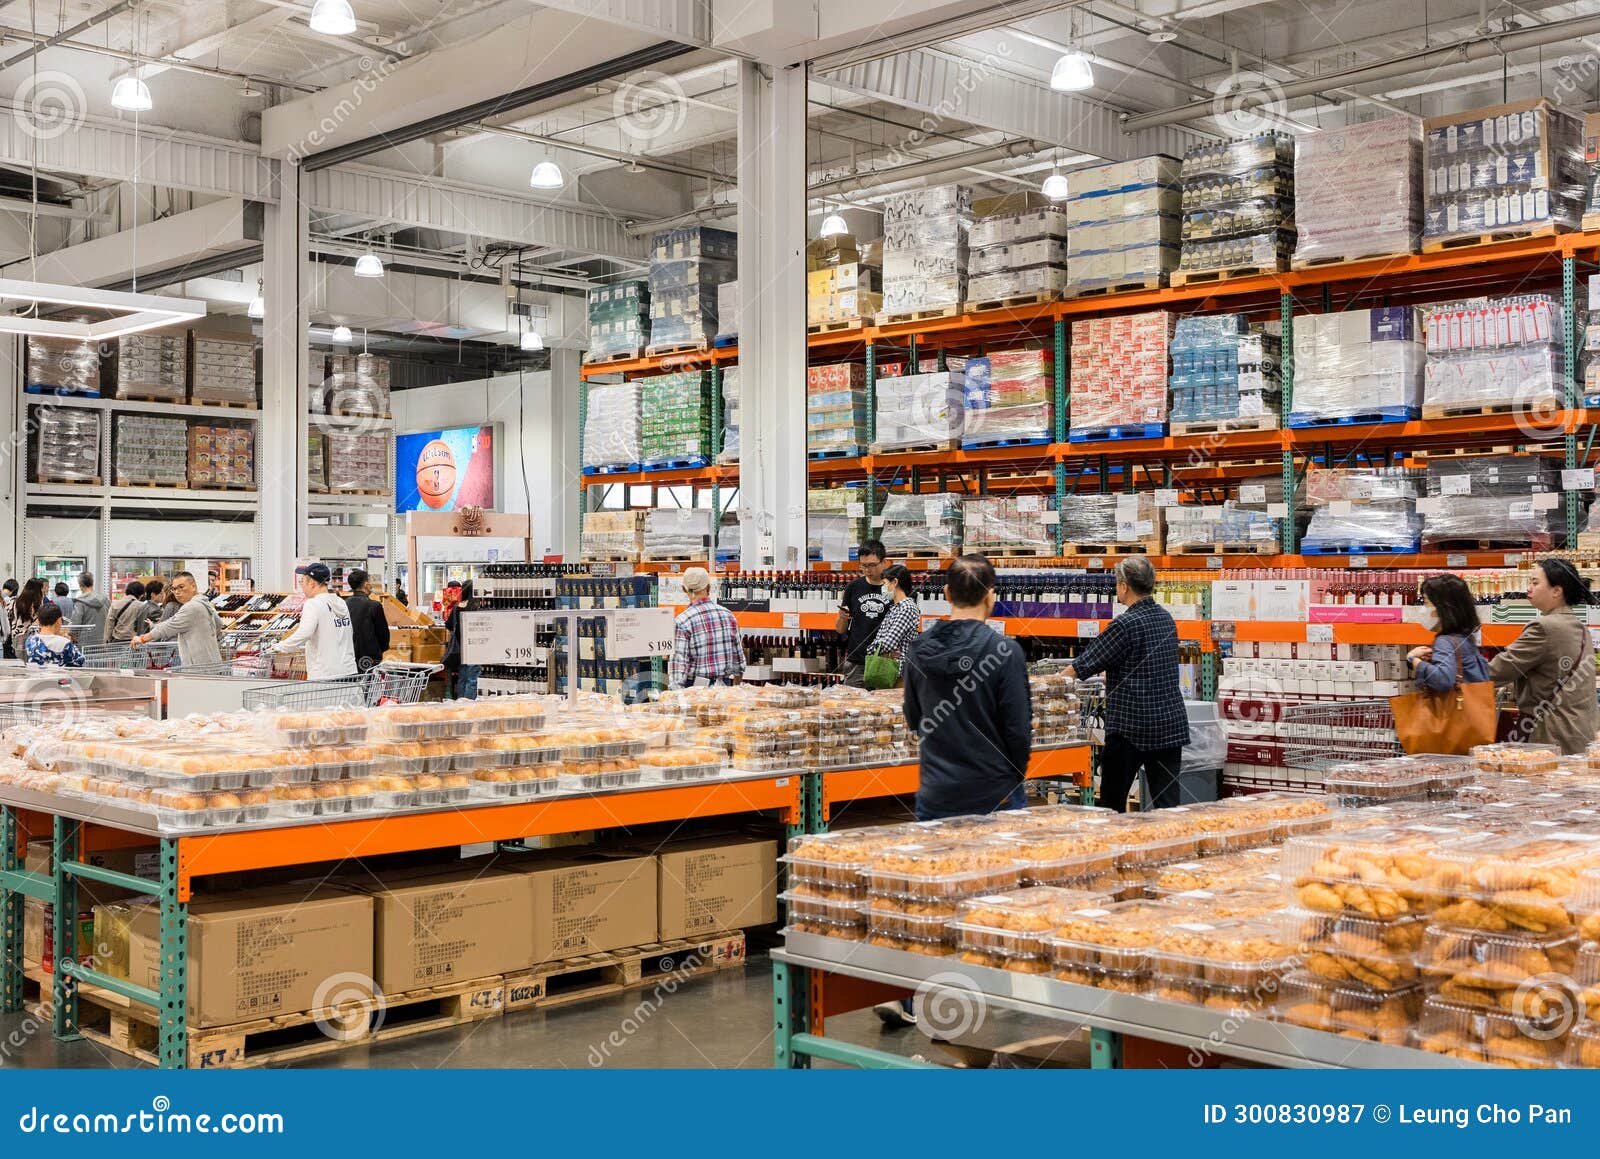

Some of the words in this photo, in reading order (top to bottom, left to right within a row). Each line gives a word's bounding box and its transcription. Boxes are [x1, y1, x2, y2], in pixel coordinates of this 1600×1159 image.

[648, 641, 654, 652] $
[656, 640, 673, 650] 198
[504, 648, 512, 659] $
[514, 647, 532, 658] 198
